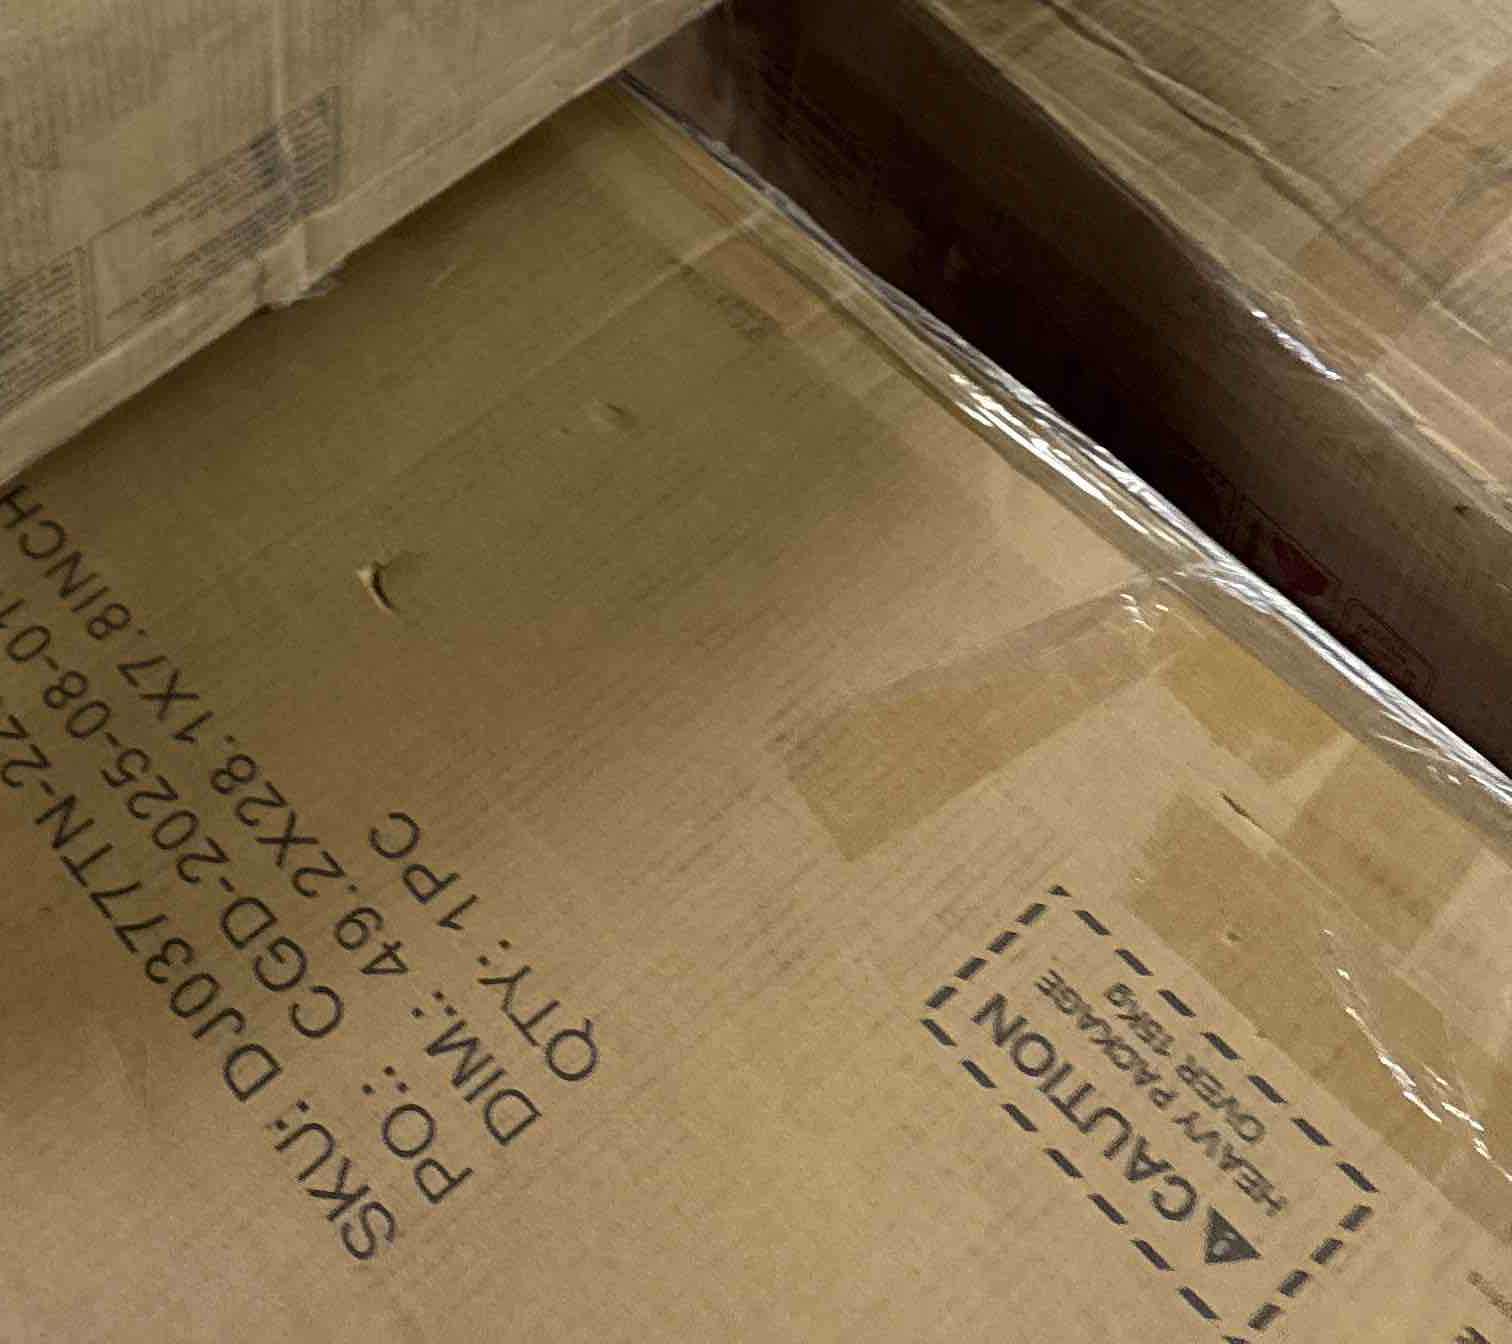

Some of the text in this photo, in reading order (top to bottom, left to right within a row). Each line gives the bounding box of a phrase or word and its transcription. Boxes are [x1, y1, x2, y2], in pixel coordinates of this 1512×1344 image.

[368, 811, 600, 1083] QTY: 1PC
[971, 993, 1200, 1222] CAUTION
[1033, 968, 1288, 1218] HEAVY PACKAGE
[1104, 982, 1266, 1144] OVER 15KG
[266, 1100, 396, 1261] SKU:
